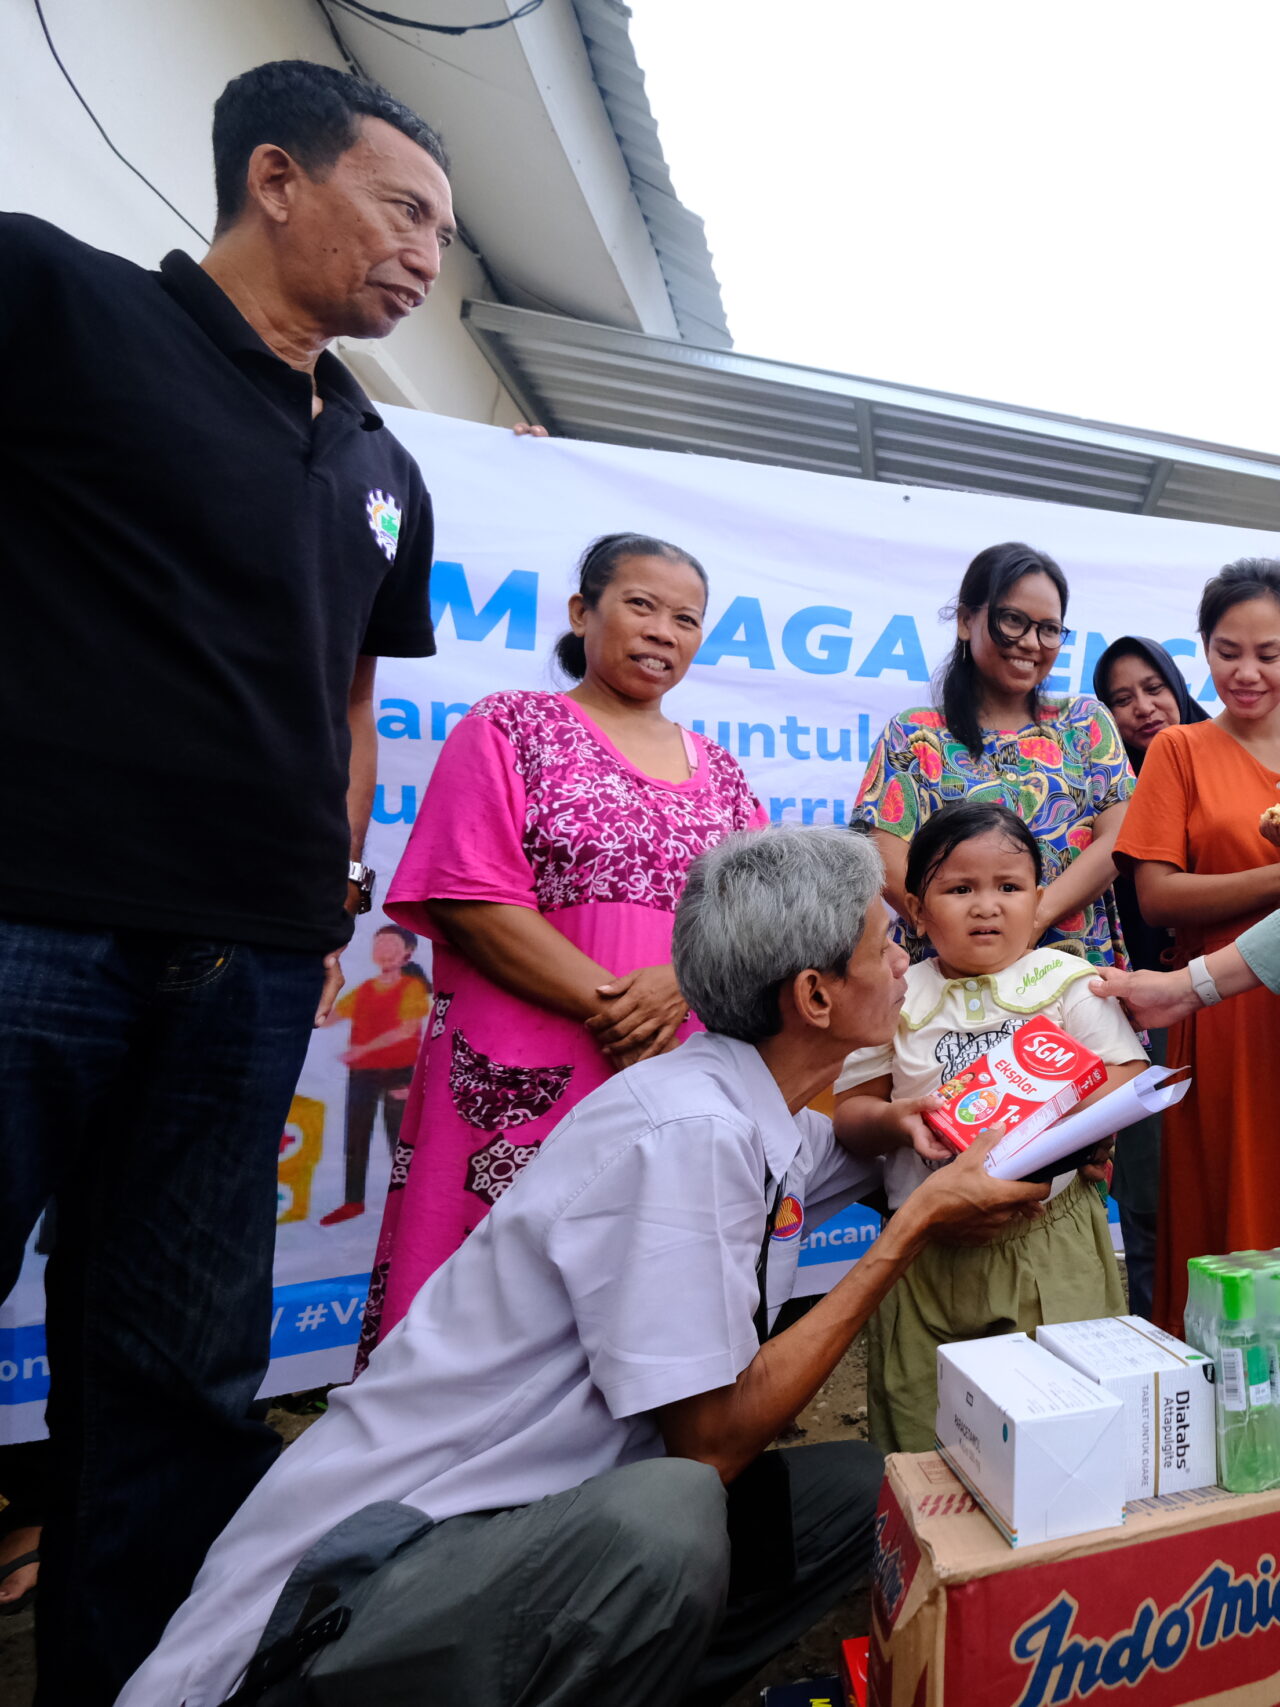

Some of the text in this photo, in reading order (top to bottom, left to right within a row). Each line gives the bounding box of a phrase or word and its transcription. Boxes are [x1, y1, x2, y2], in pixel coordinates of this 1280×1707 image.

[994, 1059, 1038, 1095] Eksplor
[1023, 1036, 1075, 1068] SGM
[1162, 1397, 1174, 1469] Attapulgite
[1175, 1390, 1190, 1470] Diatabs
